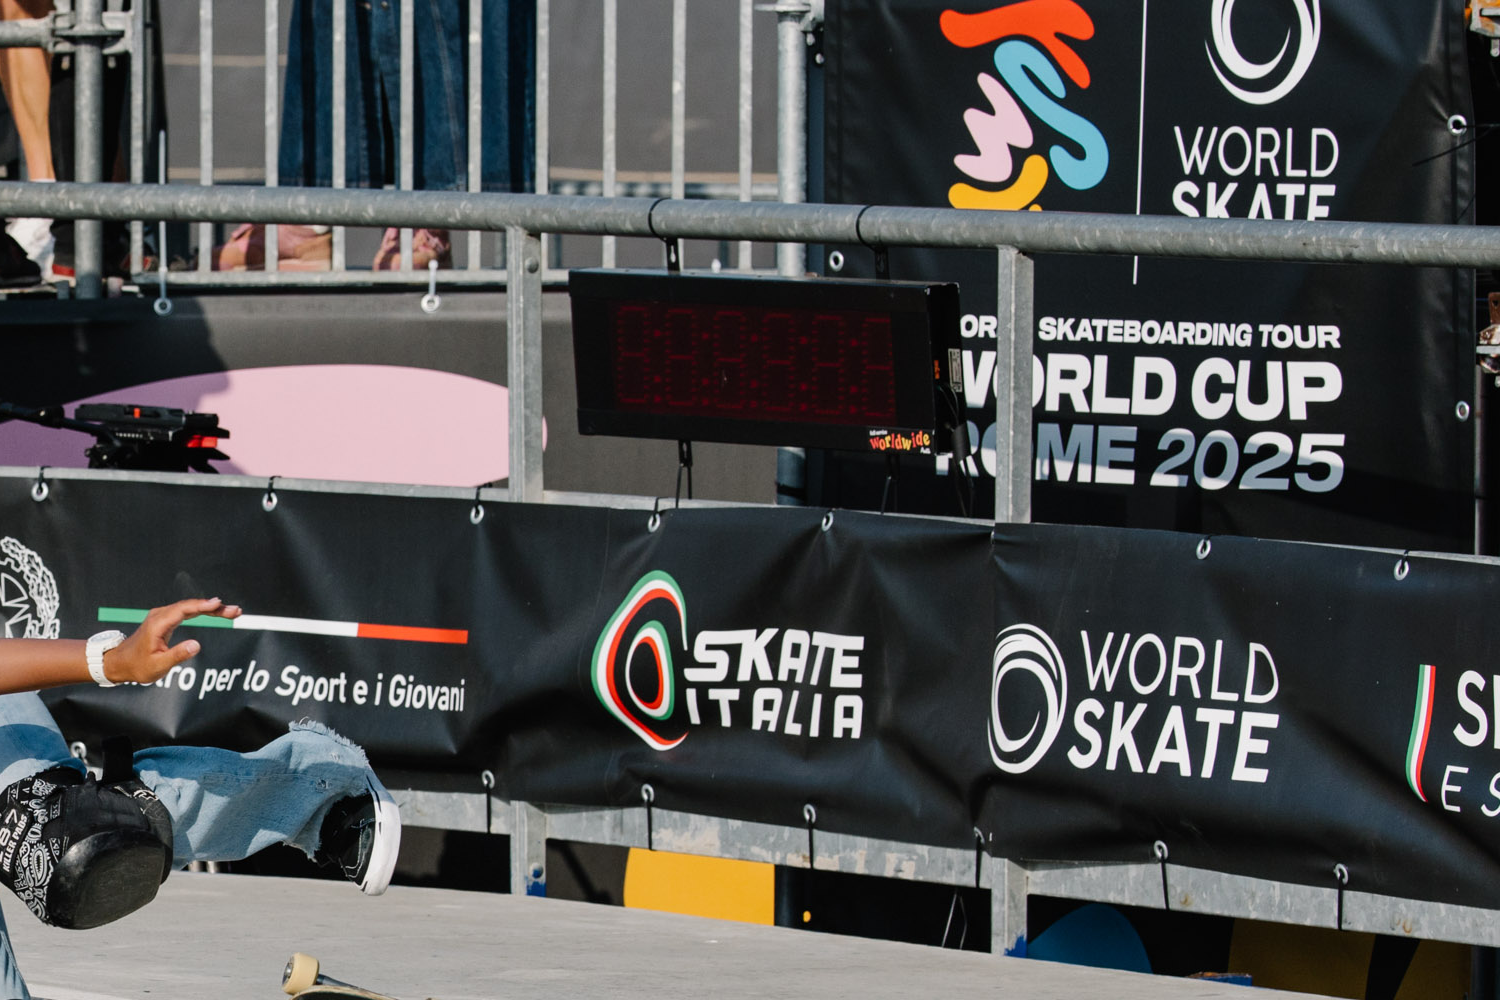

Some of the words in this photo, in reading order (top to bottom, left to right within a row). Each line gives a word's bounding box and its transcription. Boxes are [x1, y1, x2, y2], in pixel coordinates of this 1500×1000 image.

[1173, 125, 1340, 178] WORLD
[1037, 316, 1253, 347] SKATEBOARDING
[1258, 323, 1342, 349] TOUR
[1190, 356, 1344, 422] CUP
[1148, 427, 1346, 494] 2025
[198, 667, 243, 700] per
[242, 660, 270, 692] lo
[274, 664, 348, 706] Sport
[352, 679, 368, 704] e
[374, 673, 384, 706] i
[388, 673, 466, 712] Giovani
[683, 627, 865, 689] SKATE
[1080, 629, 1280, 704] WORLD
[685, 687, 864, 740] ITALIA
[1066, 697, 1280, 784] SKATE
[1440, 764, 1470, 813] E
[2, 840, 17, 872] KILLER
[11, 813, 28, 841] PADS
